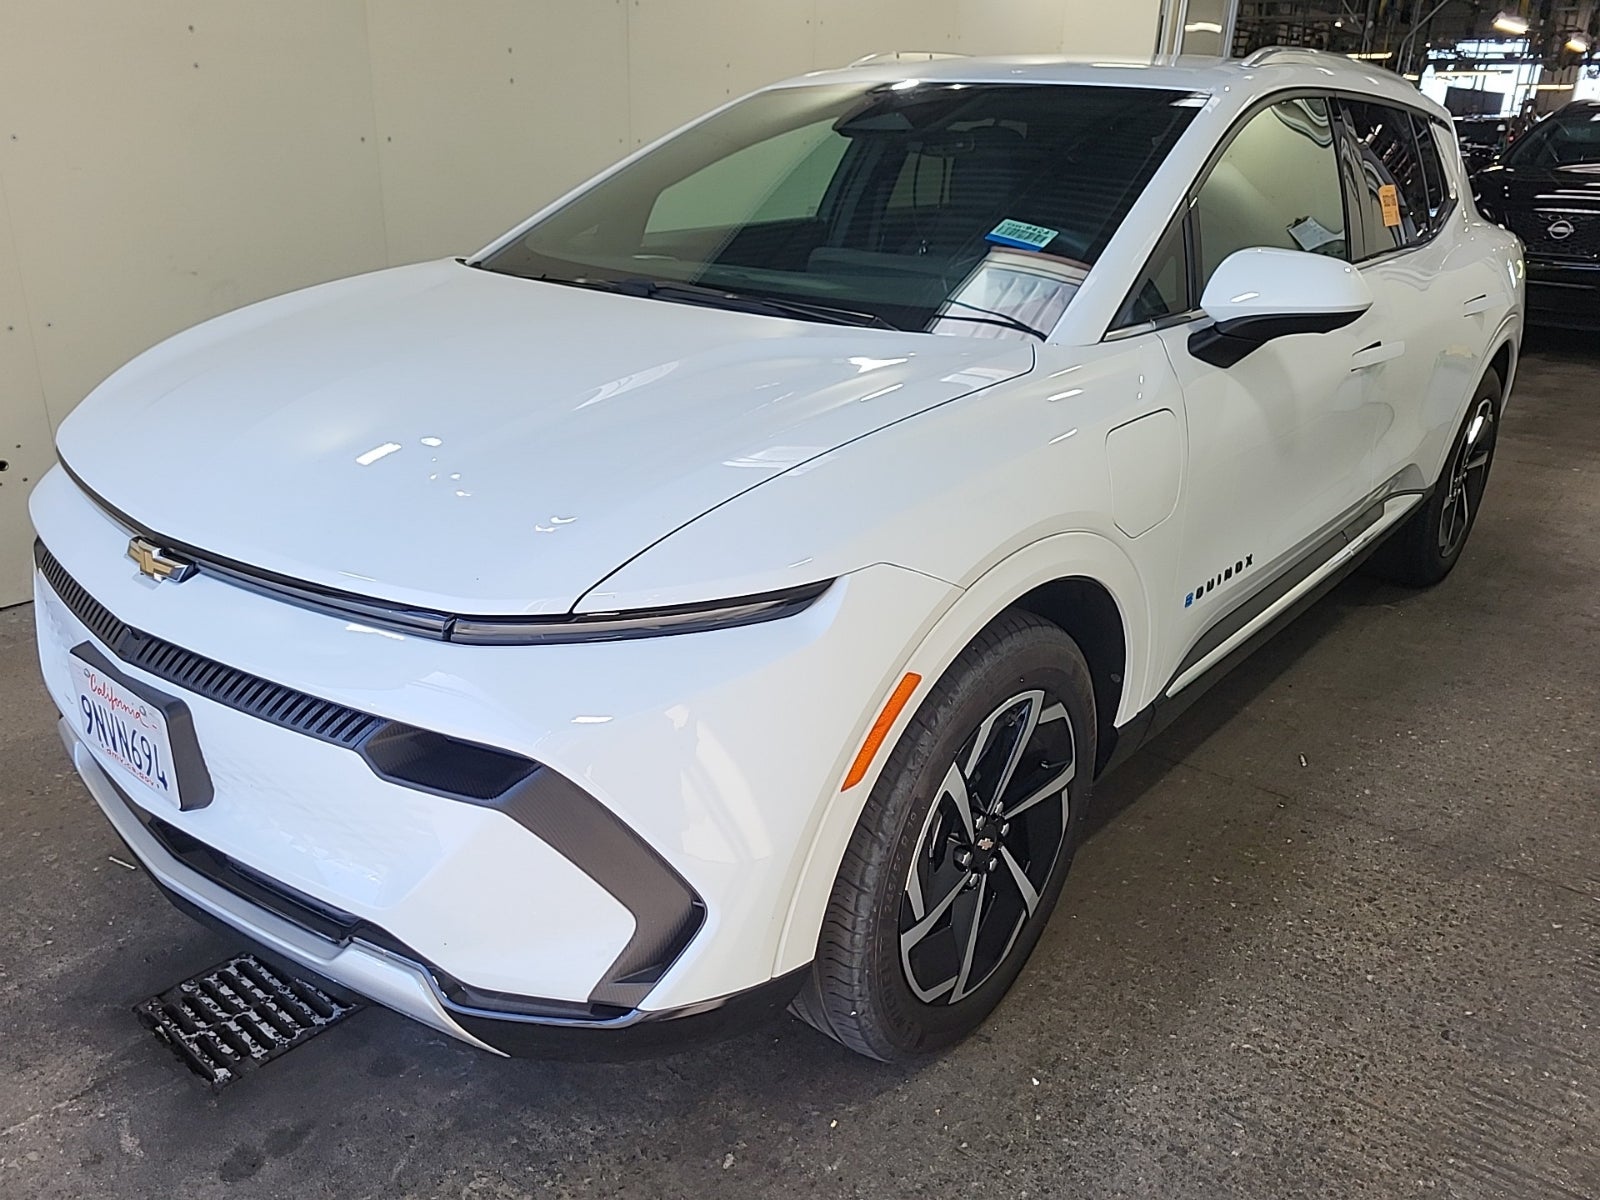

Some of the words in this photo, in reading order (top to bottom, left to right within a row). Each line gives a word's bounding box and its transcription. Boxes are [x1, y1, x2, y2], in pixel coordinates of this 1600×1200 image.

[1184, 553, 1253, 608] EQUINOX
[91, 674, 148, 728] California
[81, 695, 168, 791] 9NVN694
